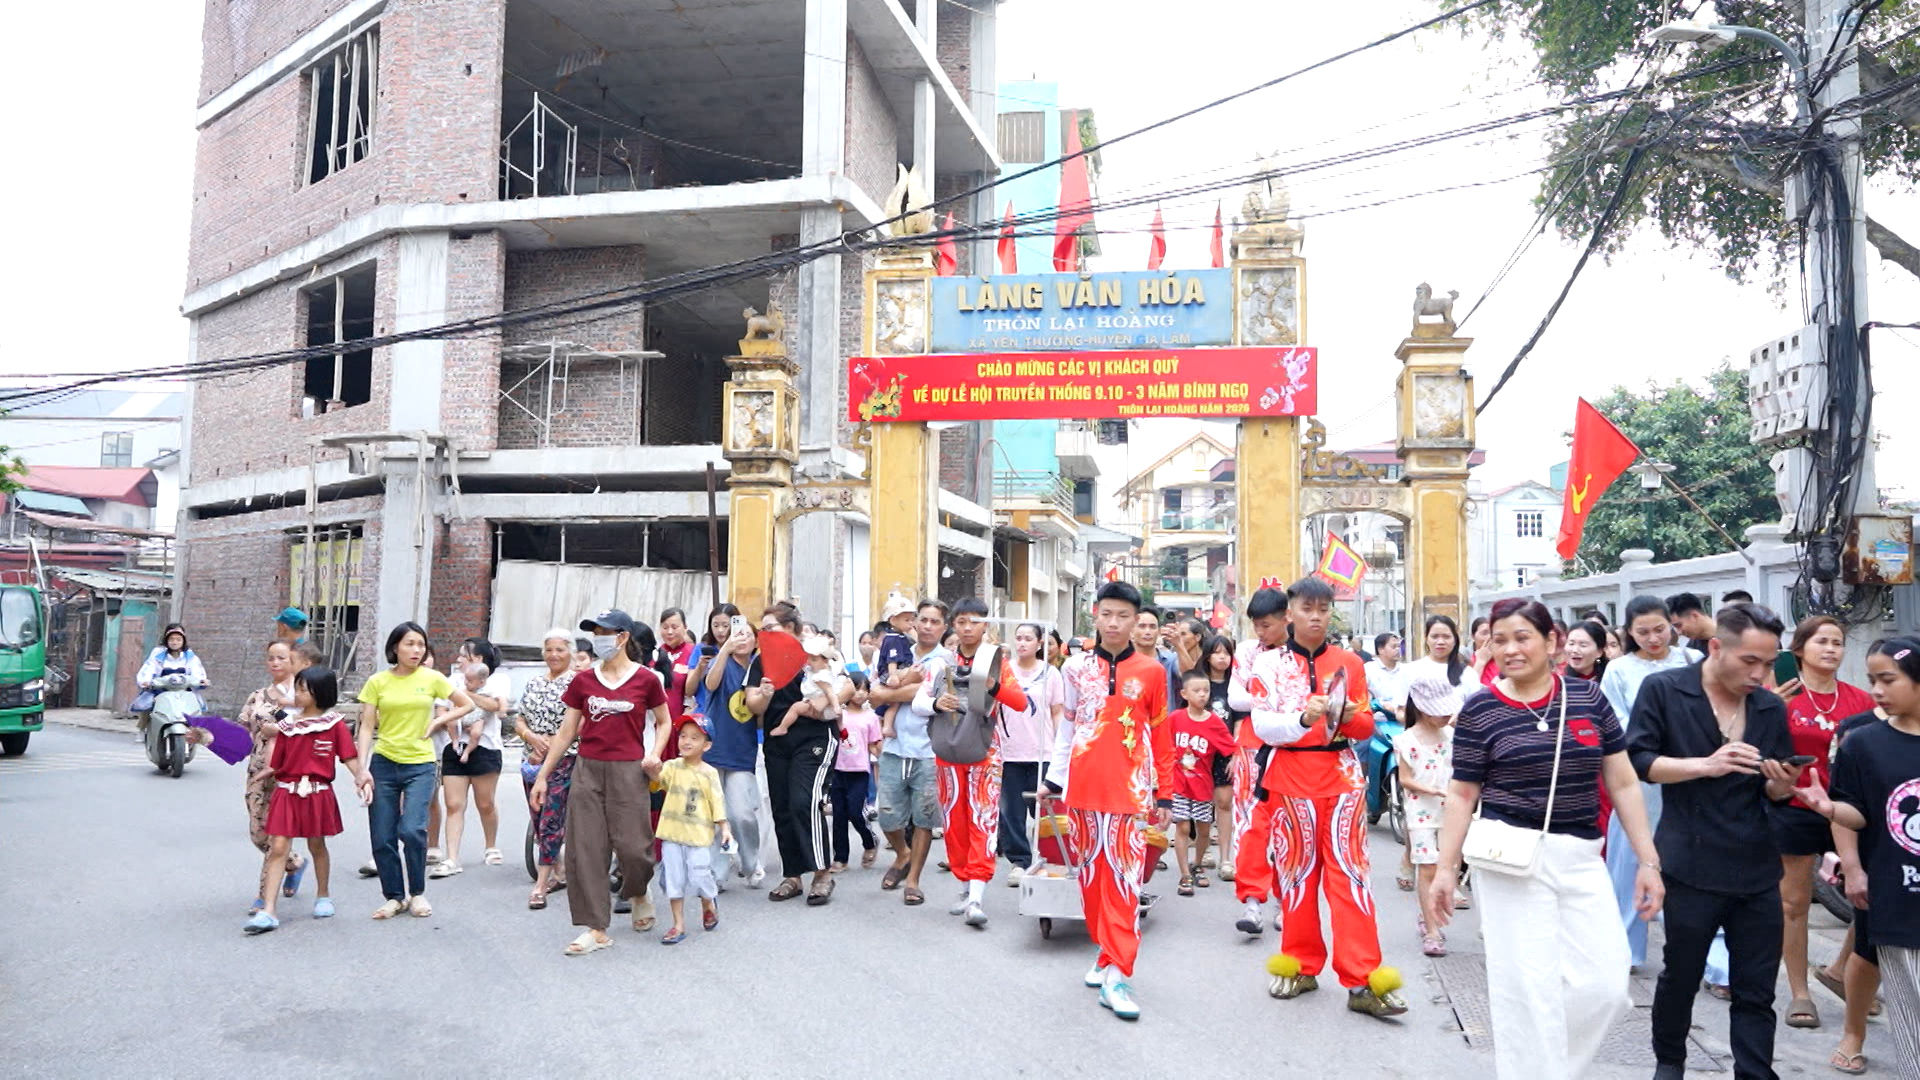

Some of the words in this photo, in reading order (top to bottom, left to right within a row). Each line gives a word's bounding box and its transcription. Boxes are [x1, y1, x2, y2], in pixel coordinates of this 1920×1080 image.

[957, 275, 1043, 312] LÀNG
[1056, 273, 1122, 309] VĂN
[1138, 272, 1205, 306] HÓA
[983, 314, 1041, 332] THÔN
[1049, 316, 1085, 332] LẠI
[1096, 308, 1177, 329] HOÀNG
[977, 359, 1012, 377] CHÀO
[1015, 358, 1055, 377] MỪNG
[1058, 357, 1085, 377] CÁC
[1088, 360, 1101, 378] VỊ
[1104, 357, 1150, 375] KHÁCH
[1153, 355, 1180, 375] QUÝ
[932, 386, 951, 406] DỰ
[952, 382, 967, 402] LỄ
[970, 384, 993, 405] HỘI
[995, 382, 1045, 401] TRUYỀN
[1048, 381, 1092, 401] THỐNG
[1095, 384, 1123, 400] 9.10
[1136, 384, 1145, 400] 3
[1147, 381, 1180, 399] NĂM
[1183, 381, 1217, 398] BÍNH
[1219, 382, 1249, 402] NGỌ
[1118, 403, 1144, 414] THÔN
[1146, 404, 1162, 415] LẠI
[1163, 401, 1198, 414] HOÀNG
[1199, 402, 1223, 414] NĂM
[1175, 731, 1209, 754] 1849
